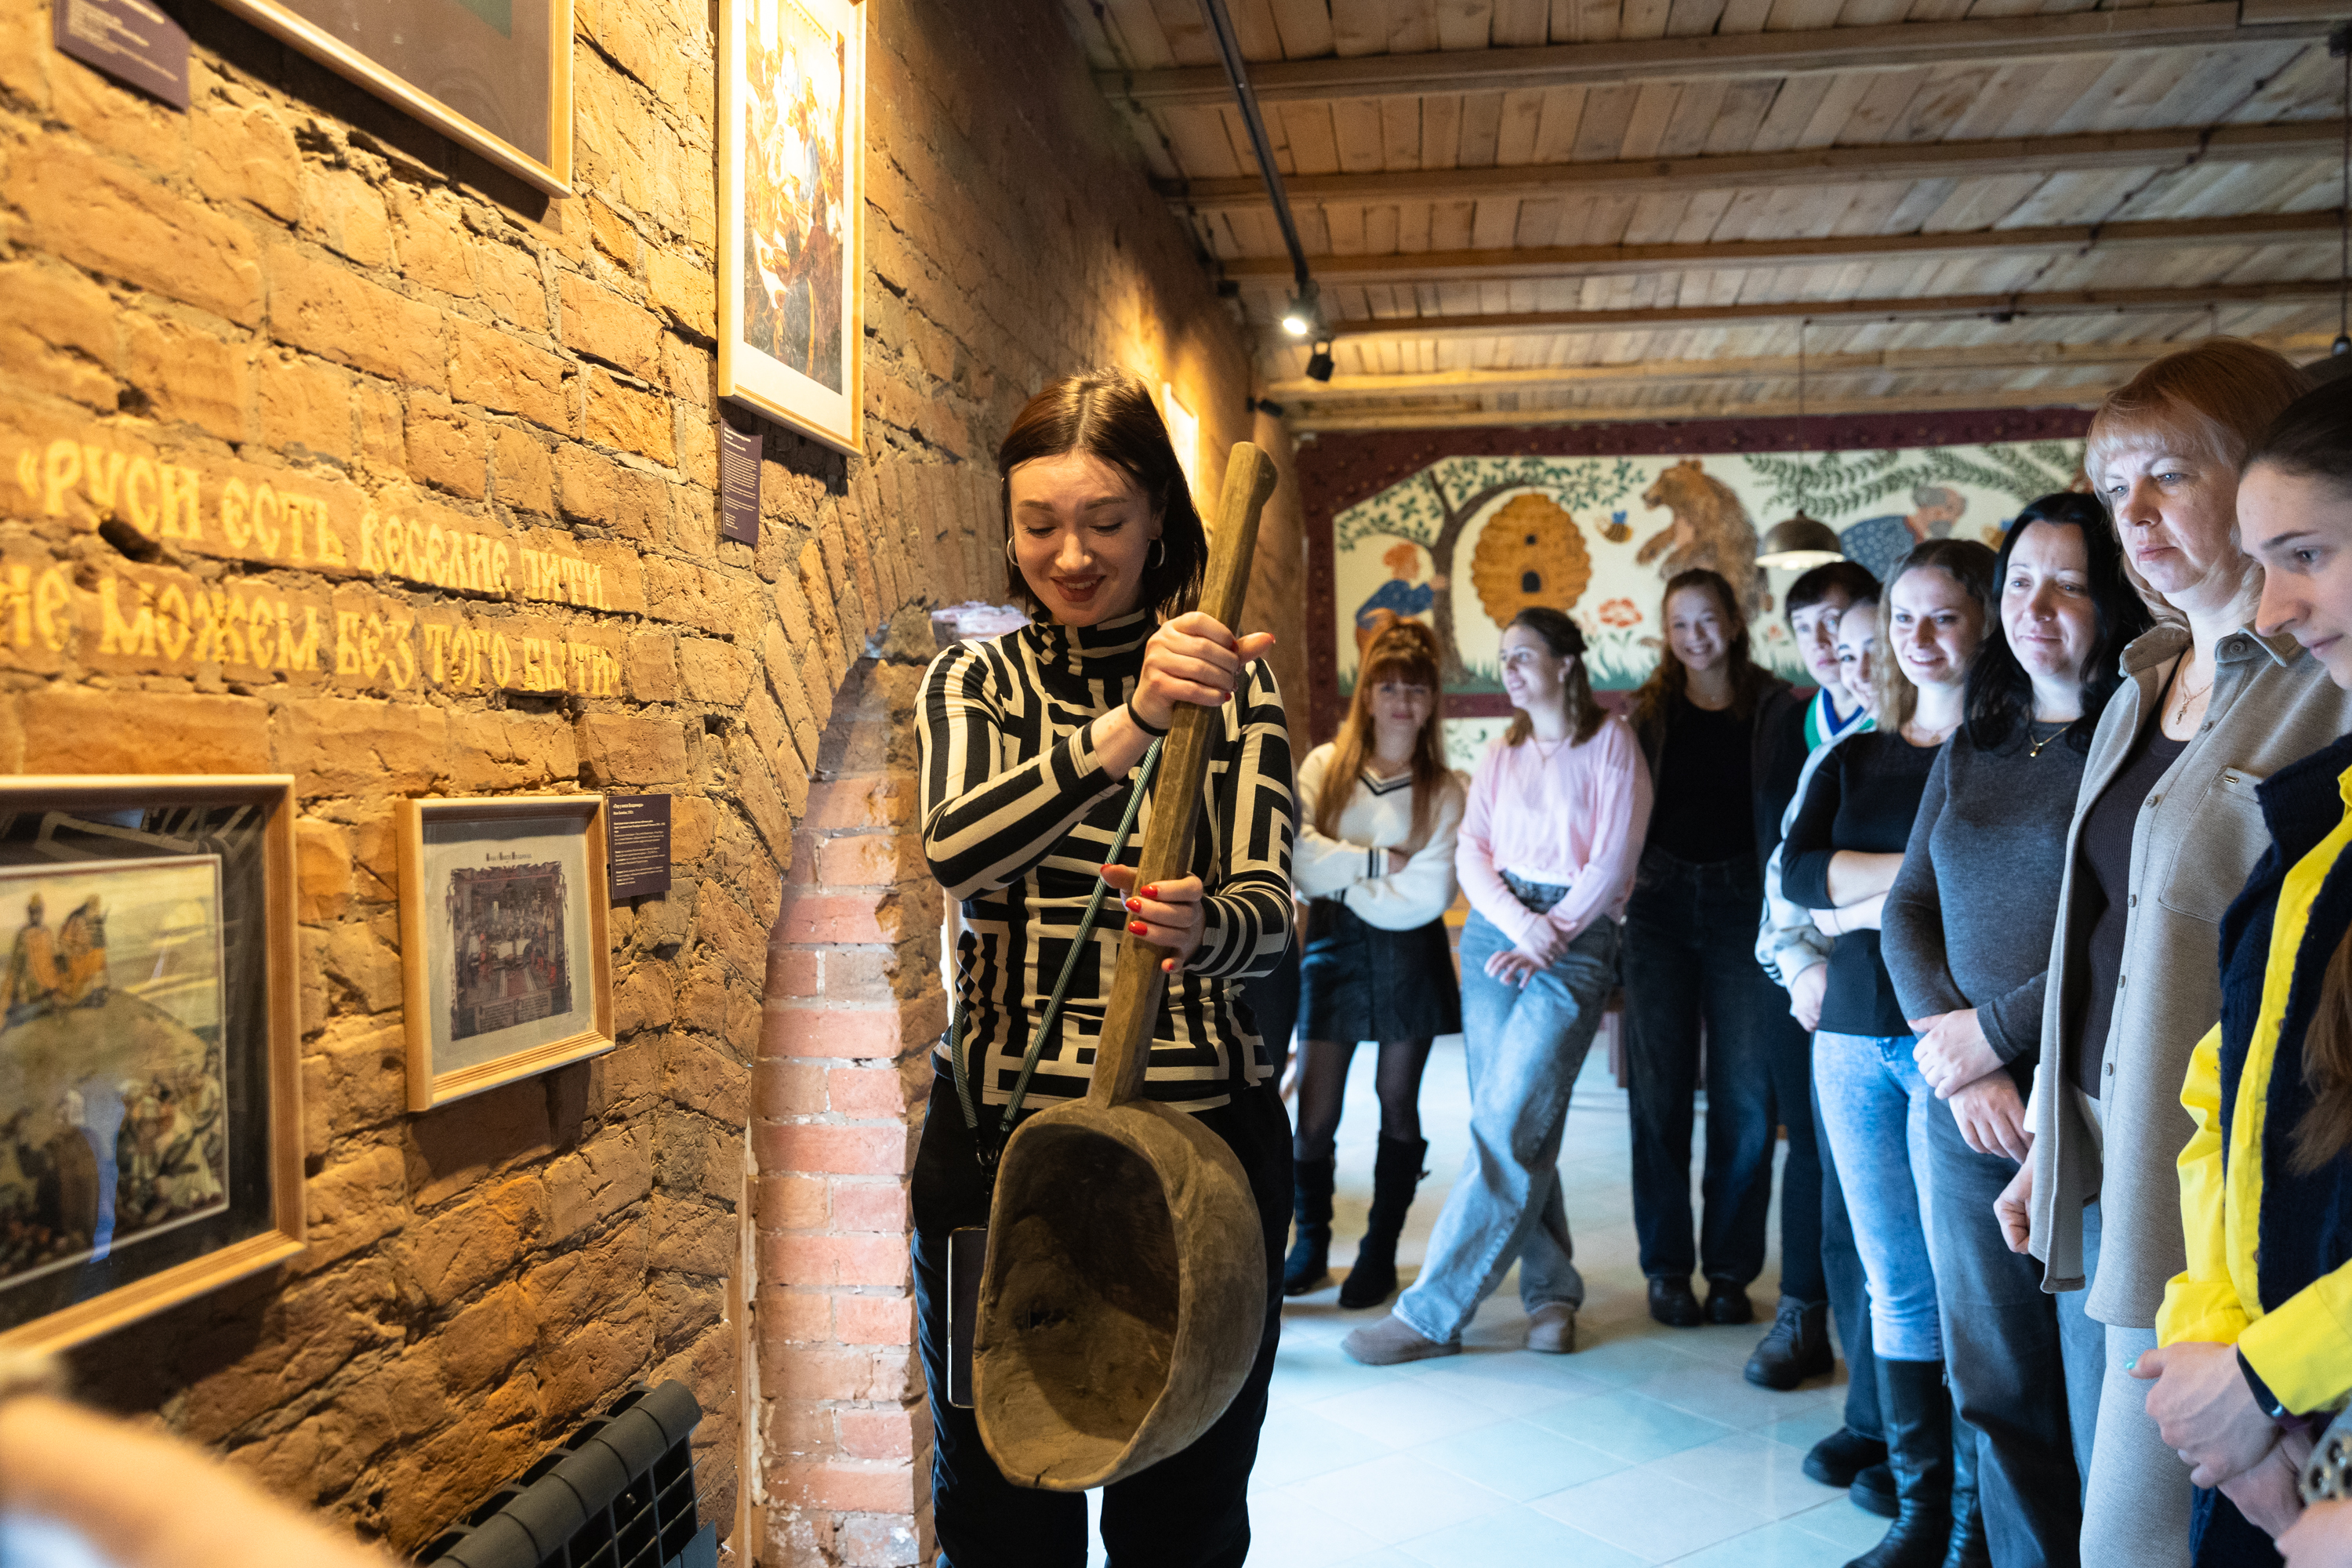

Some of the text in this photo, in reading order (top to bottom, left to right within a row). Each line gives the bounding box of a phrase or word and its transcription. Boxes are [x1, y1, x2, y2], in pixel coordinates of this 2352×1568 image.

[221, 477, 347, 568] ЕСТЬ
[359, 511, 510, 599] ВЕСЕЛИЕ
[98, 577, 320, 670] МОЖЕМ
[336, 611, 414, 689] БЕЗ
[423, 624, 511, 688] ТОГО
